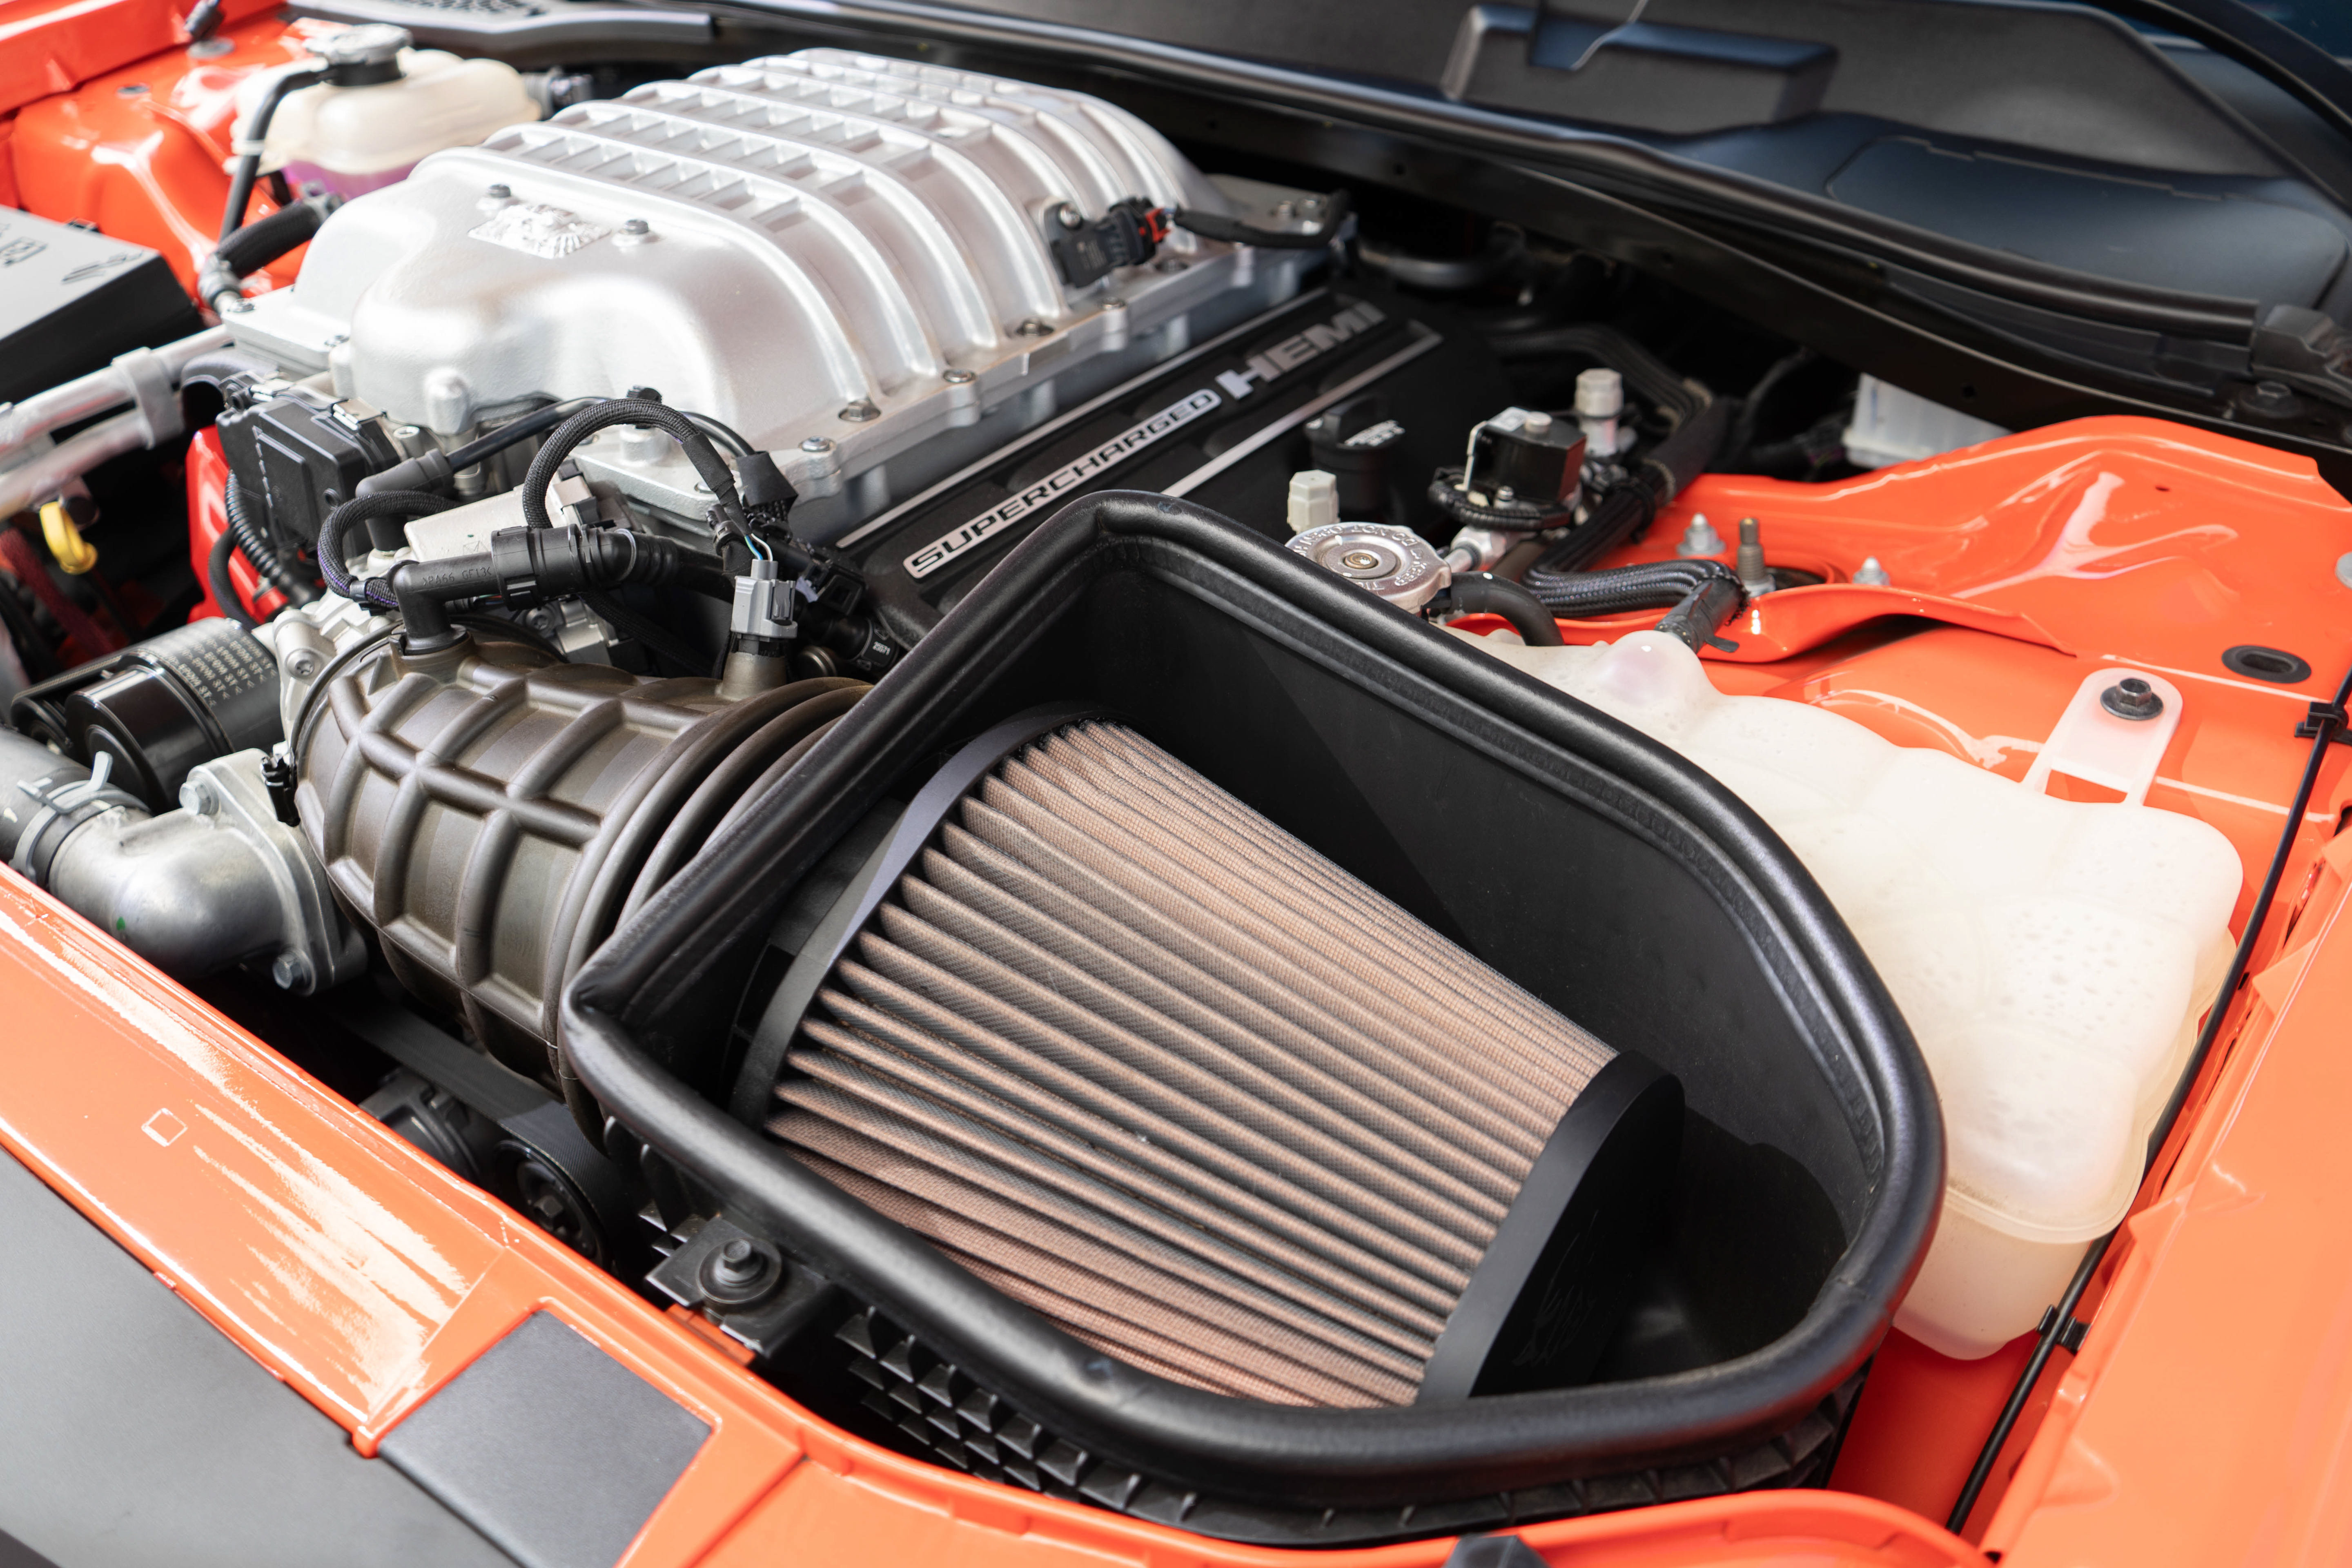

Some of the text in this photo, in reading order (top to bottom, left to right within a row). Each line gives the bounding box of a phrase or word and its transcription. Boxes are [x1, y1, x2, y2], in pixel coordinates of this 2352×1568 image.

[911, 301, 1386, 572] SUPERCHARGED HEMI
[1351, 525, 1386, 537] NOT
[1391, 532, 1418, 547] DO
[1394, 561, 1428, 587] KEEP
